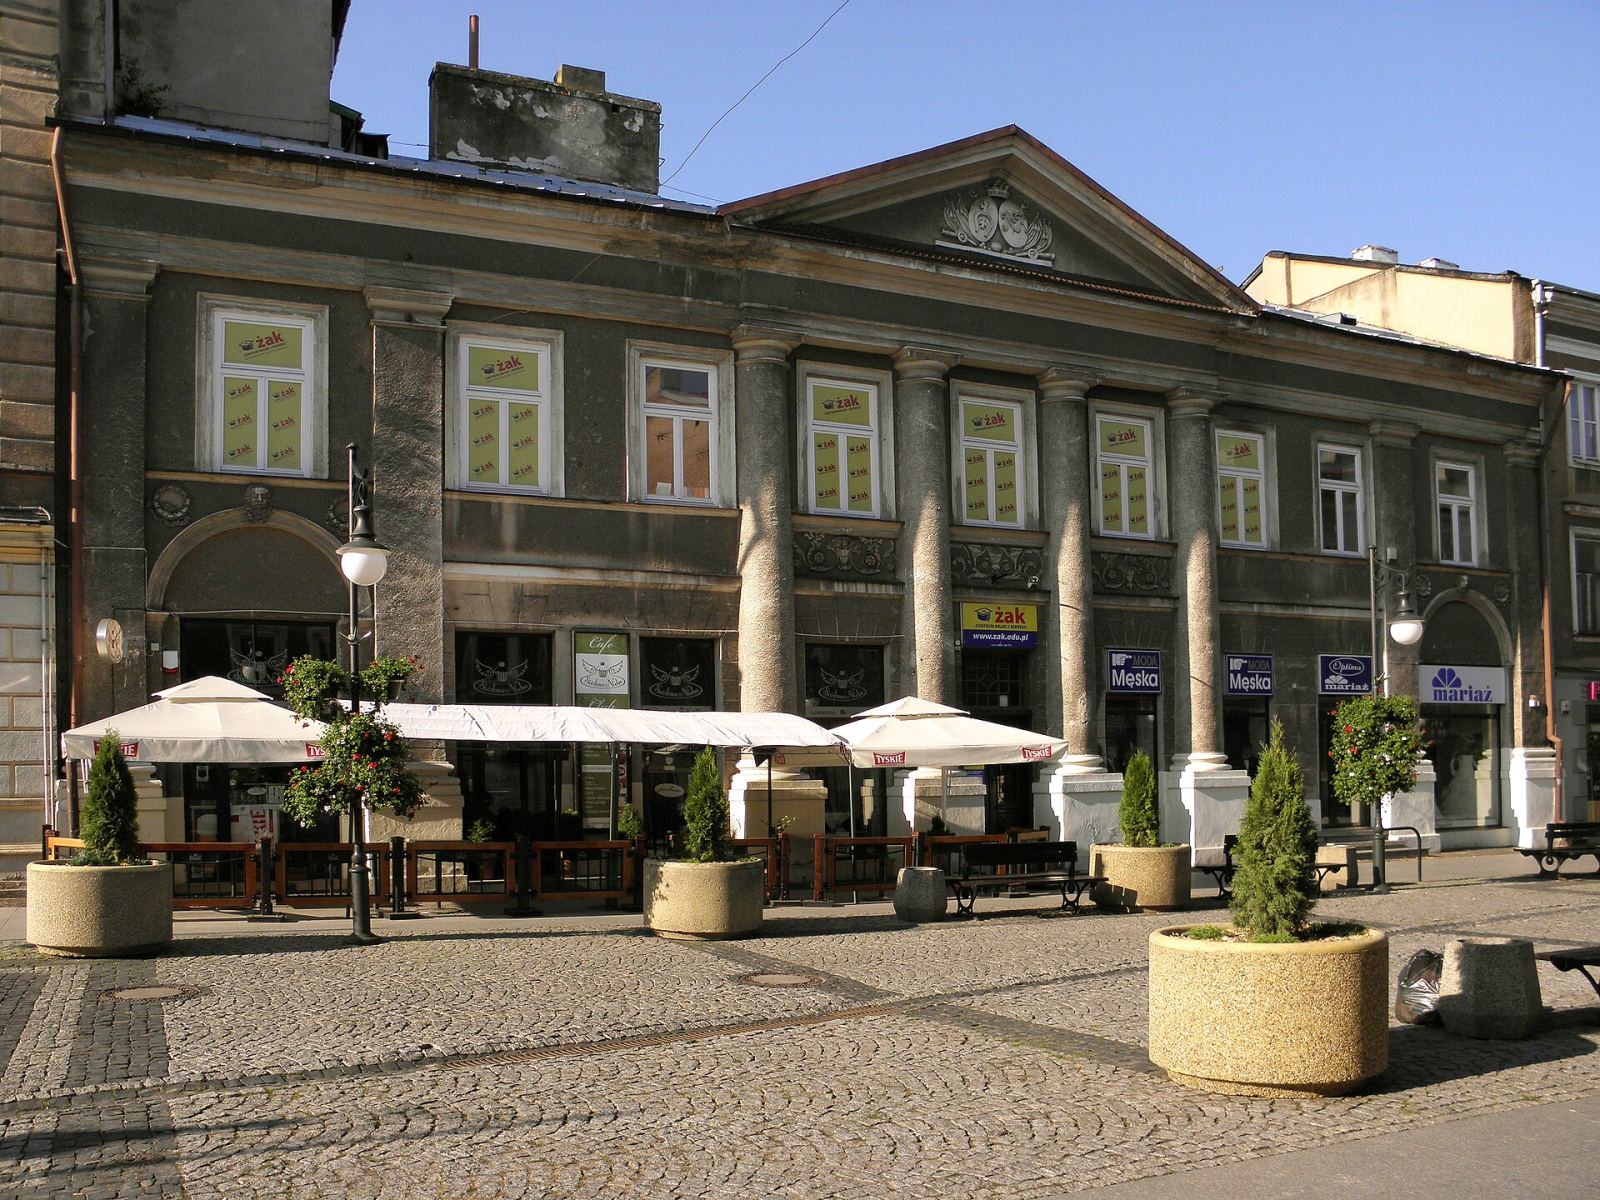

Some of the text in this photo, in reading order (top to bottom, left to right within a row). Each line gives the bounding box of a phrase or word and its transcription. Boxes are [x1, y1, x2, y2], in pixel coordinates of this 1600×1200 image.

[256, 331, 284, 348] żak
[496, 356, 522, 372] żak
[237, 384, 251, 394] żak
[281, 387, 295, 397] żak
[836, 395, 860, 409] żak
[480, 405, 493, 414] żak
[520, 409, 533, 417] żak
[237, 414, 251, 424] żak
[280, 417, 295, 426] żak
[984, 411, 1006, 426] żak
[480, 433, 493, 442] żak
[1118, 429, 1136, 441] żak
[520, 437, 533, 446] żak
[823, 440, 836, 448] żak
[237, 444, 251, 454] żak
[280, 447, 294, 456] żak
[856, 444, 867, 452] żak
[1234, 443, 1250, 455] żak
[481, 462, 493, 471] żak
[520, 465, 533, 473] żak
[824, 464, 836, 472] żak
[856, 467, 868, 475] żak
[825, 488, 837, 496] żak
[857, 491, 868, 499] żak
[995, 607, 1026, 624] żak
[972, 632, 1029, 642] www.zak.edu.pl
[1133, 655, 1157, 666] MODA
[1248, 659, 1270, 671] MODA
[1332, 661, 1362, 674] Optima
[1112, 669, 1158, 688] Męska
[1229, 673, 1271, 691] Męska
[1325, 683, 1369, 691] mariaż
[1433, 685, 1493, 702] mariaż
[1024, 747, 1051, 758] TYSKIE
[875, 753, 903, 763] TYSKIE
